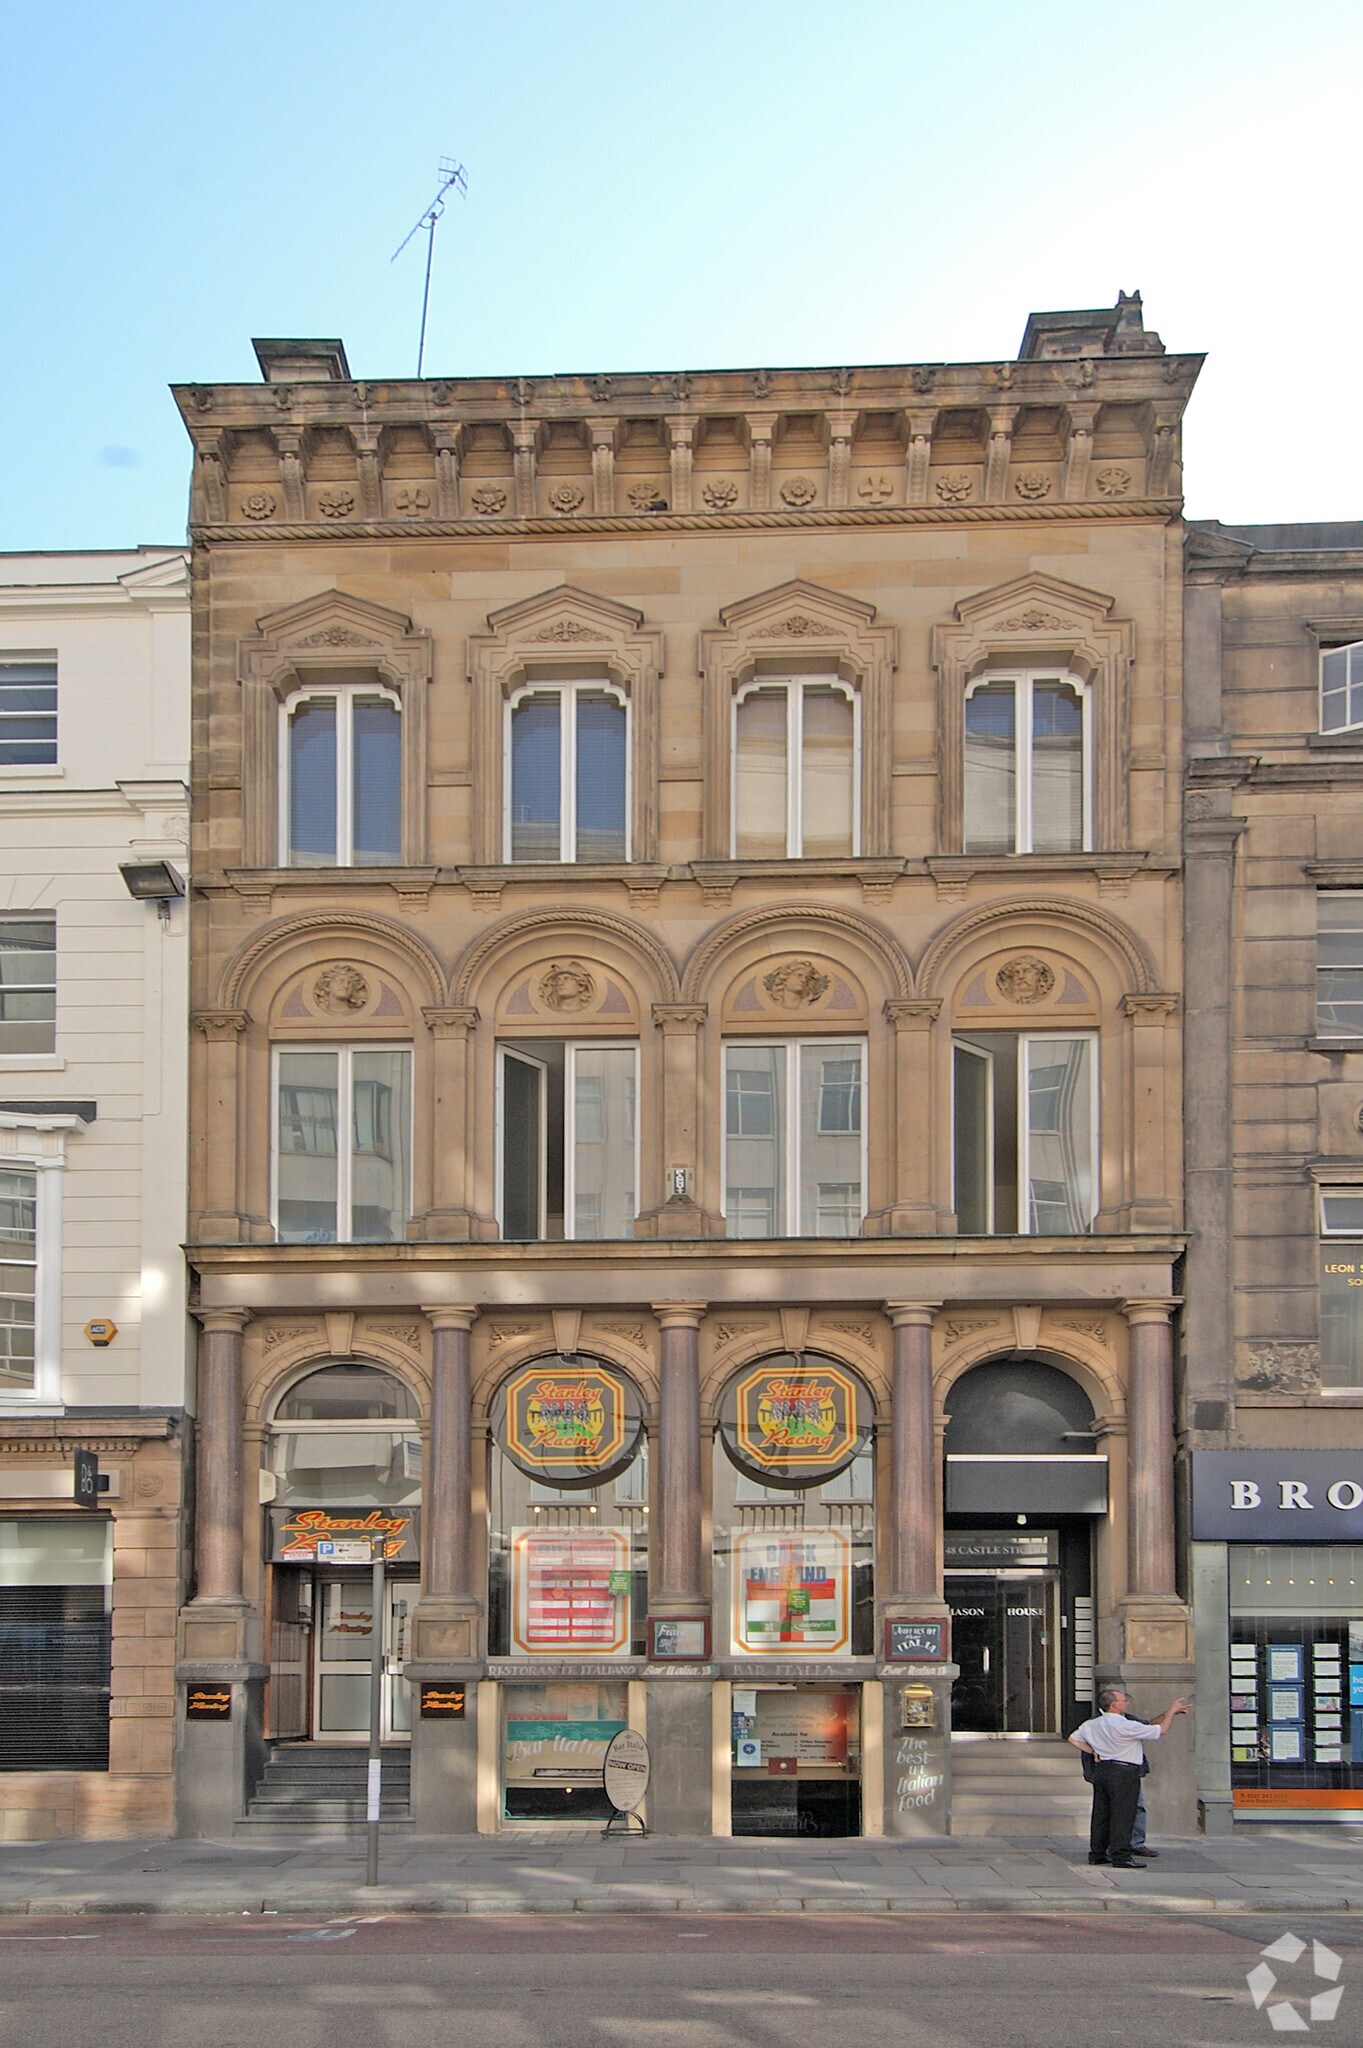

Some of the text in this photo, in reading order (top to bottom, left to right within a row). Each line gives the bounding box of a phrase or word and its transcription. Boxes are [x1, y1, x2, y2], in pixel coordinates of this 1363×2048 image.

[1324, 1264, 1355, 1273] LEON
[527, 1380, 604, 1405] Stanley
[758, 1379, 835, 1404] Stanley
[528, 1429, 604, 1454] Racing
[758, 1428, 835, 1454] Racing
[1229, 1481, 1363, 1510] BRO
[280, 1511, 411, 1537] Stanley
[322, 1544, 332, 1554] P
[945, 1546, 957, 1554] 48
[958, 1546, 1001, 1554] CASTLE
[1007, 1607, 1046, 1616] HOUSE
[581, 1665, 636, 1676] ITALIANO
[642, 1665, 699, 1675] Bar Italia
[733, 1665, 834, 1676] BAR ITALIA
[880, 1665, 907, 1675] Bar
[511, 1734, 607, 1763] Bar Italia
[613, 1740, 644, 1752] Bar Italia
[901, 1737, 928, 1750] The
[896, 1751, 937, 1764] best
[609, 1760, 646, 1773] NOW OPEN
[908, 1764, 924, 1775] in
[897, 1774, 944, 1794] Italian
